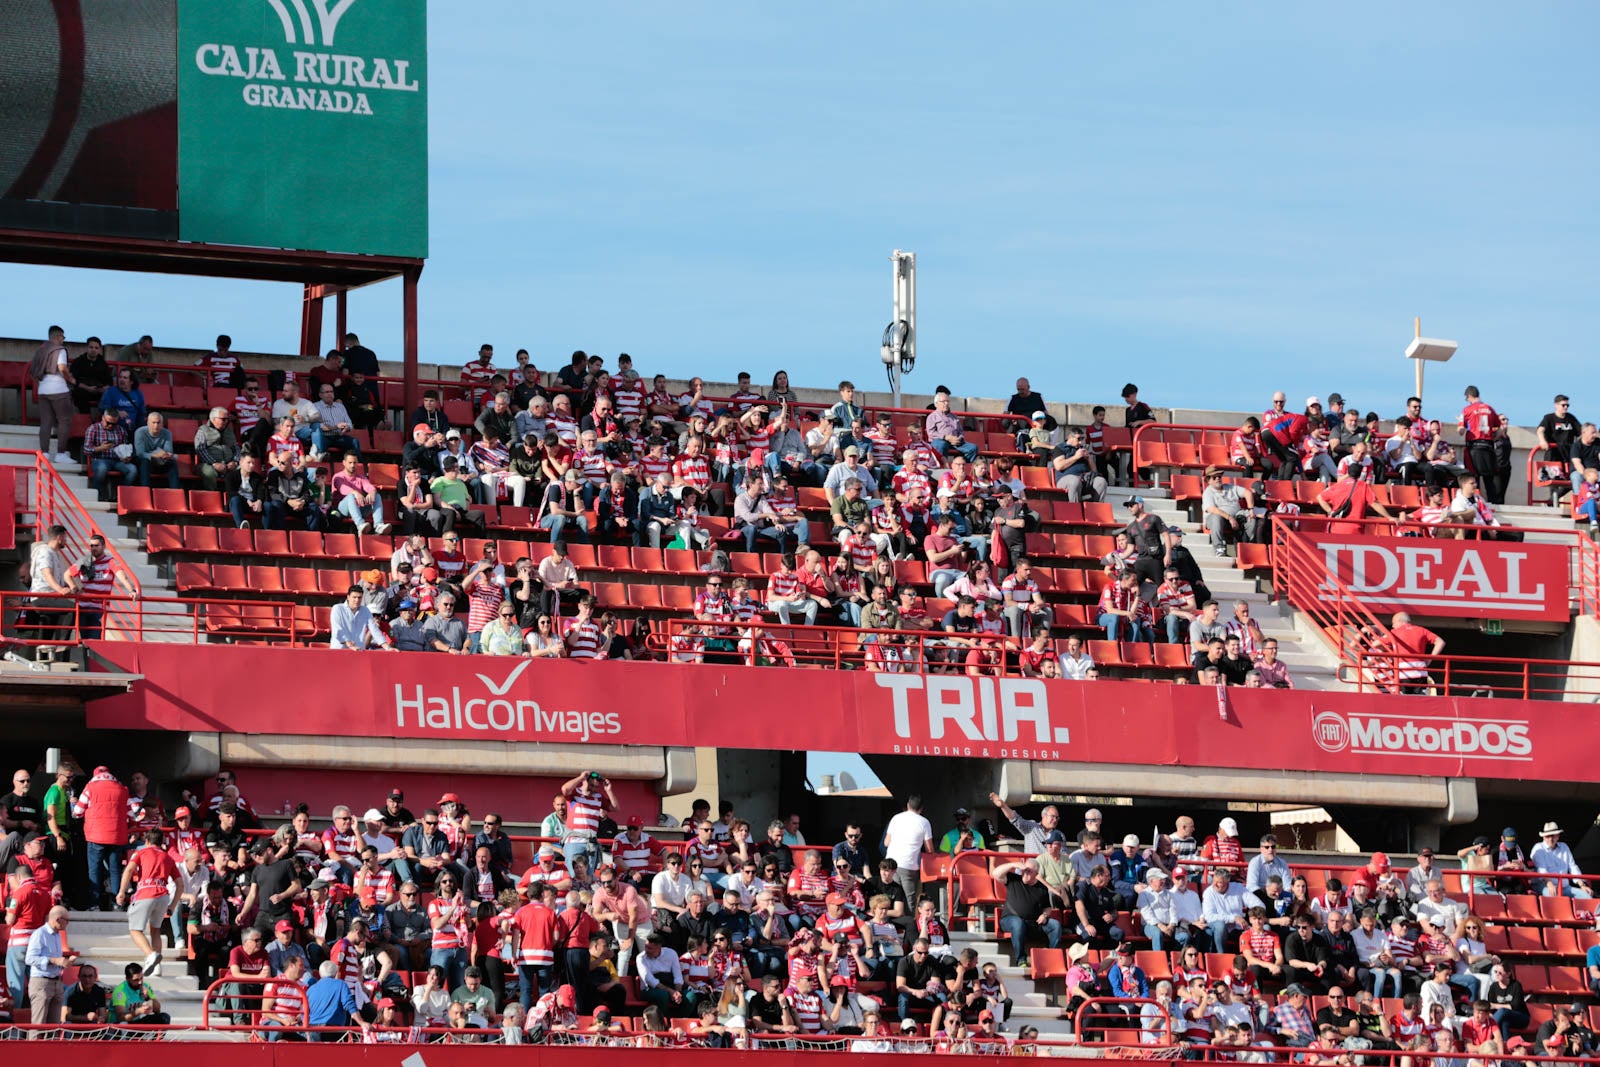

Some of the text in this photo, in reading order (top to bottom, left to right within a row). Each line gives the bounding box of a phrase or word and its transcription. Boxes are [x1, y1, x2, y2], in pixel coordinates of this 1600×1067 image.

[195, 43, 419, 92] CAJA RURAL
[242, 84, 374, 115] GRANADA
[1554, 422, 1573, 430] FILA
[1317, 542, 1545, 601] IDEAL
[1321, 723, 1341, 741] FIAT
[1348, 717, 1533, 756] MotorDOS
[893, 744, 1060, 759] BUILDING & DESIGN
